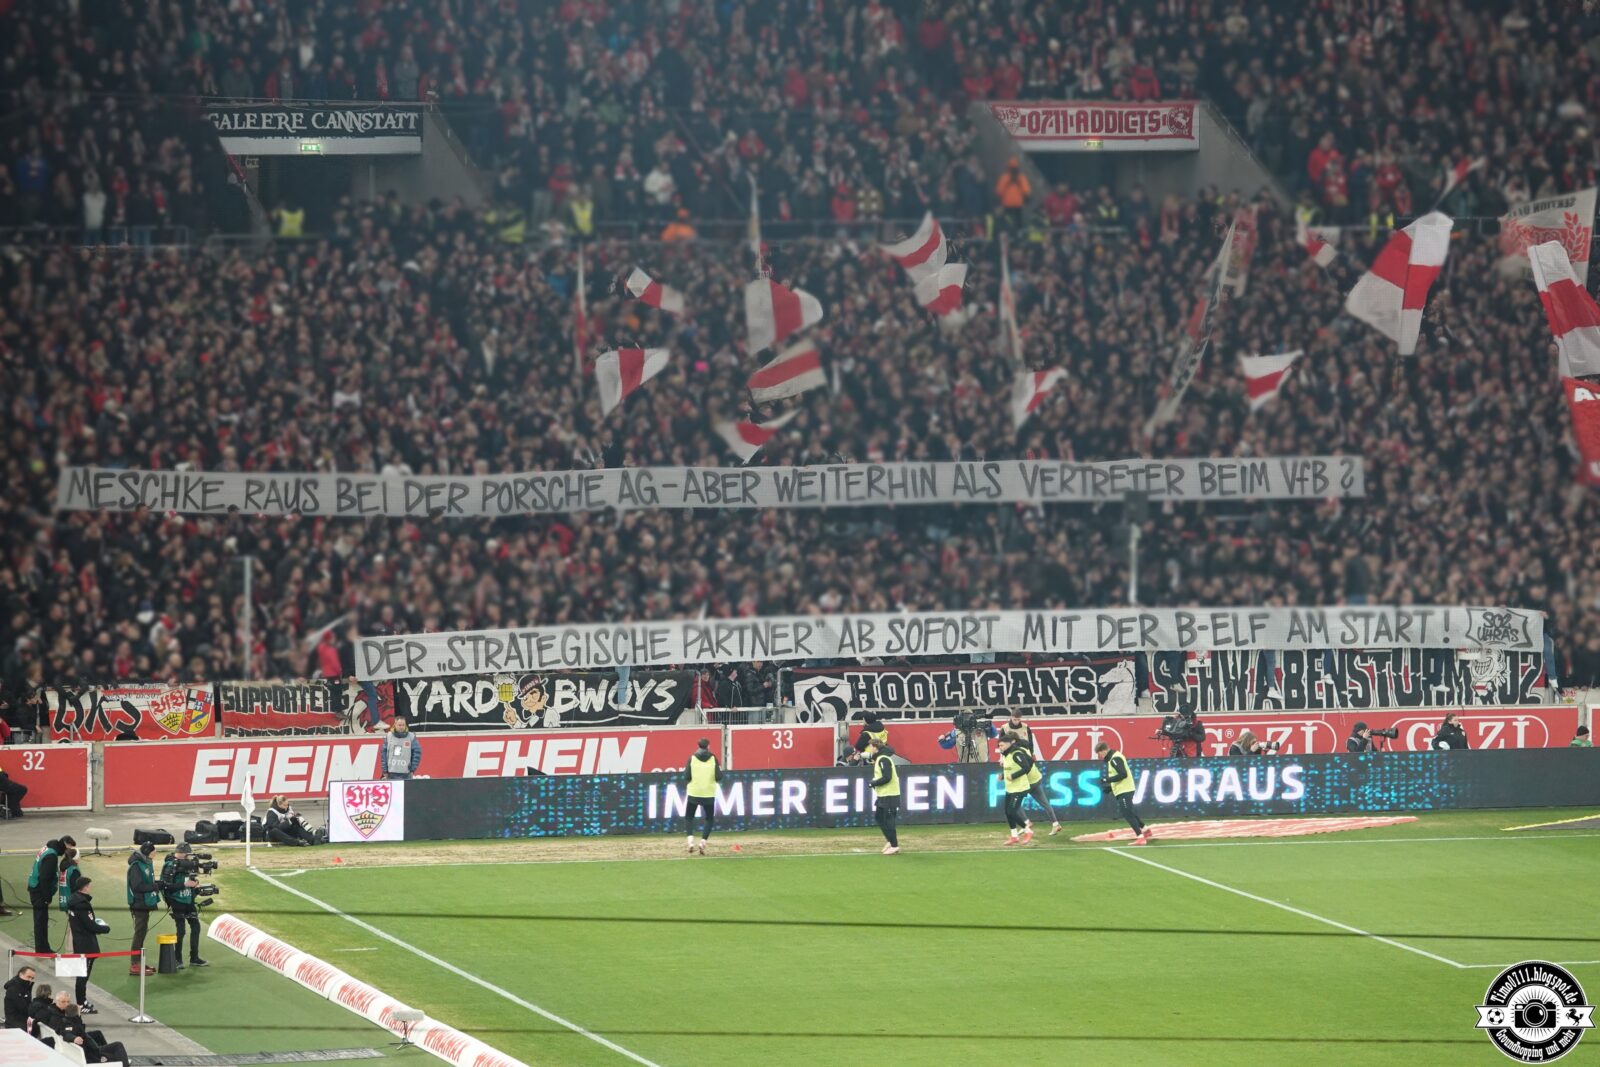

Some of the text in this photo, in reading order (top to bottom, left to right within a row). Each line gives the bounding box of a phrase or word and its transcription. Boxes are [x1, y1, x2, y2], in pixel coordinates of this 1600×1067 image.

[311, 110, 419, 133] CANNSTATT
[67, 468, 225, 511] MESCHKE
[244, 477, 320, 512] RAUS
[336, 477, 388, 514] BEI
[404, 480, 470, 514] DER
[482, 474, 606, 514] PORSCHE
[773, 465, 938, 503] WEITERHIN
[952, 462, 1003, 498] ALS
[1019, 462, 1184, 497] VERTRETER
[1198, 461, 1271, 496] BEIM
[1280, 459, 1330, 495] VfB
[361, 639, 428, 676] DER
[838, 617, 876, 655] AB
[886, 614, 1001, 653] SOFORT
[1023, 613, 1082, 650] MIT
[1096, 613, 1159, 650] DER
[1174, 611, 1270, 648] B-ELF
[1287, 610, 1330, 645] AM
[403, 679, 499, 718] YARD
[845, 667, 1098, 708] HOOLIGANS
[462, 736, 648, 779] EHEIM
[772, 730, 794, 750] 33
[22, 751, 45, 771] 32
[190, 744, 380, 797] EHEIM
[388, 758, 407, 767] OTO
[648, 779, 808, 819] IMMER
[825, 775, 965, 819] EIEN
[987, 768, 1102, 808] PSS
